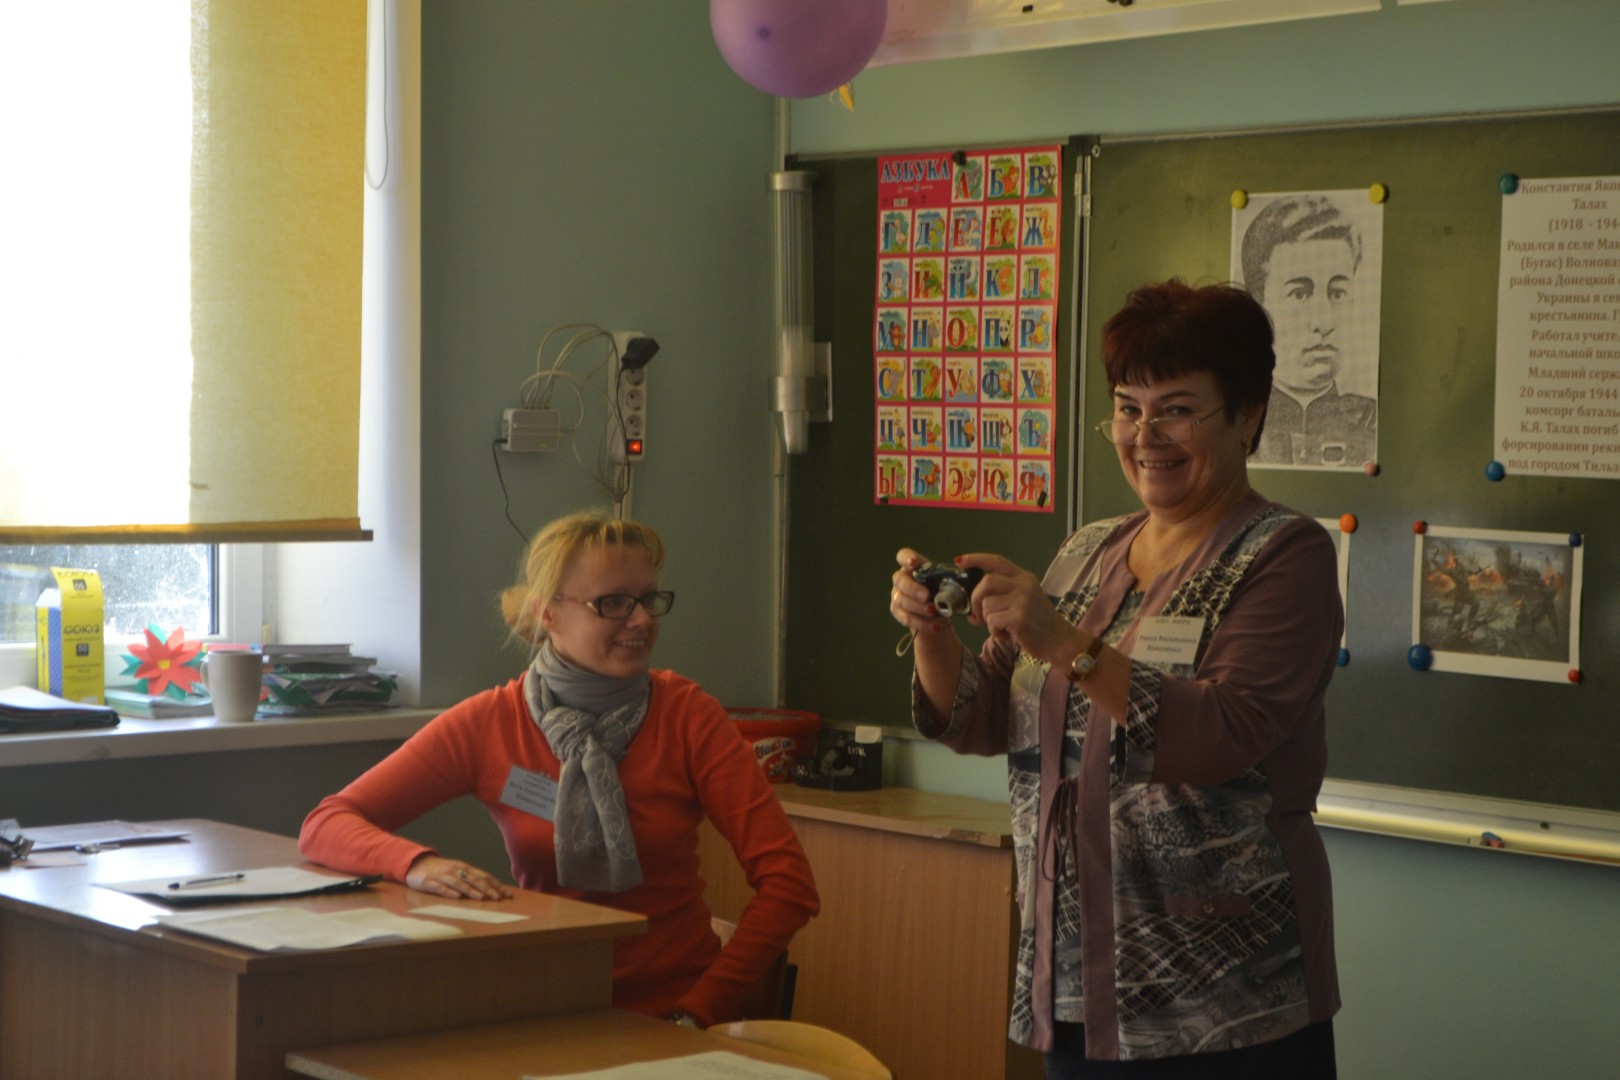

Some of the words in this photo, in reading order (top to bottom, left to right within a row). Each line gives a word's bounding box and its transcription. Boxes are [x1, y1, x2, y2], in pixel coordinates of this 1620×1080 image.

[881, 158, 950, 183] АЗБУКА
[954, 171, 970, 200] А
[990, 168, 1004, 196] Б
[1029, 165, 1044, 195] В
[1521, 182, 1592, 194] Константин
[1572, 198, 1608, 210] Талах
[1548, 218, 1584, 233] (1918
[884, 222, 896, 250] Г
[915, 222, 932, 248] Д
[952, 218, 966, 248] Е
[1022, 216, 1044, 246] Ж
[1507, 240, 1555, 252] Родился
[1558, 240, 1565, 250] в
[1568, 240, 1594, 250] селе
[1520, 257, 1563, 270] (Бугас)
[880, 271, 893, 300] З
[914, 270, 930, 299] И
[949, 264, 966, 298] Й
[985, 268, 1000, 298] К
[1022, 268, 1040, 298] Л
[1509, 276, 1552, 289] района
[1554, 274, 1615, 288] Донецкой
[1536, 292, 1590, 306] Украины
[1592, 294, 1600, 304] в
[1529, 311, 1610, 323] крестьянина.
[878, 319, 894, 350] М
[912, 319, 928, 348] Н
[947, 318, 966, 348] О
[984, 318, 1000, 348] П
[1020, 318, 1036, 348] Р
[1532, 329, 1580, 342] Работал
[1529, 348, 1593, 360] начальной
[1528, 366, 1586, 380] Младший
[878, 368, 892, 398] С
[912, 368, 926, 398] Т
[946, 368, 962, 398] У
[1020, 370, 1038, 399] Х
[1520, 387, 1535, 398] 20
[1536, 388, 1586, 402] октября
[1590, 388, 1618, 399] 1944
[1526, 406, 1574, 418] комсорг
[912, 418, 928, 446] Ч
[1546, 422, 1580, 434] Талах
[1583, 423, 1620, 436] погиб
[1502, 438, 1589, 452] форсировании
[1508, 459, 1528, 470] под
[1531, 460, 1580, 472] городом
[878, 466, 896, 495] Ы
[948, 468, 965, 498] Э
[982, 468, 1002, 500] Ю
[1018, 472, 1035, 501] Я
